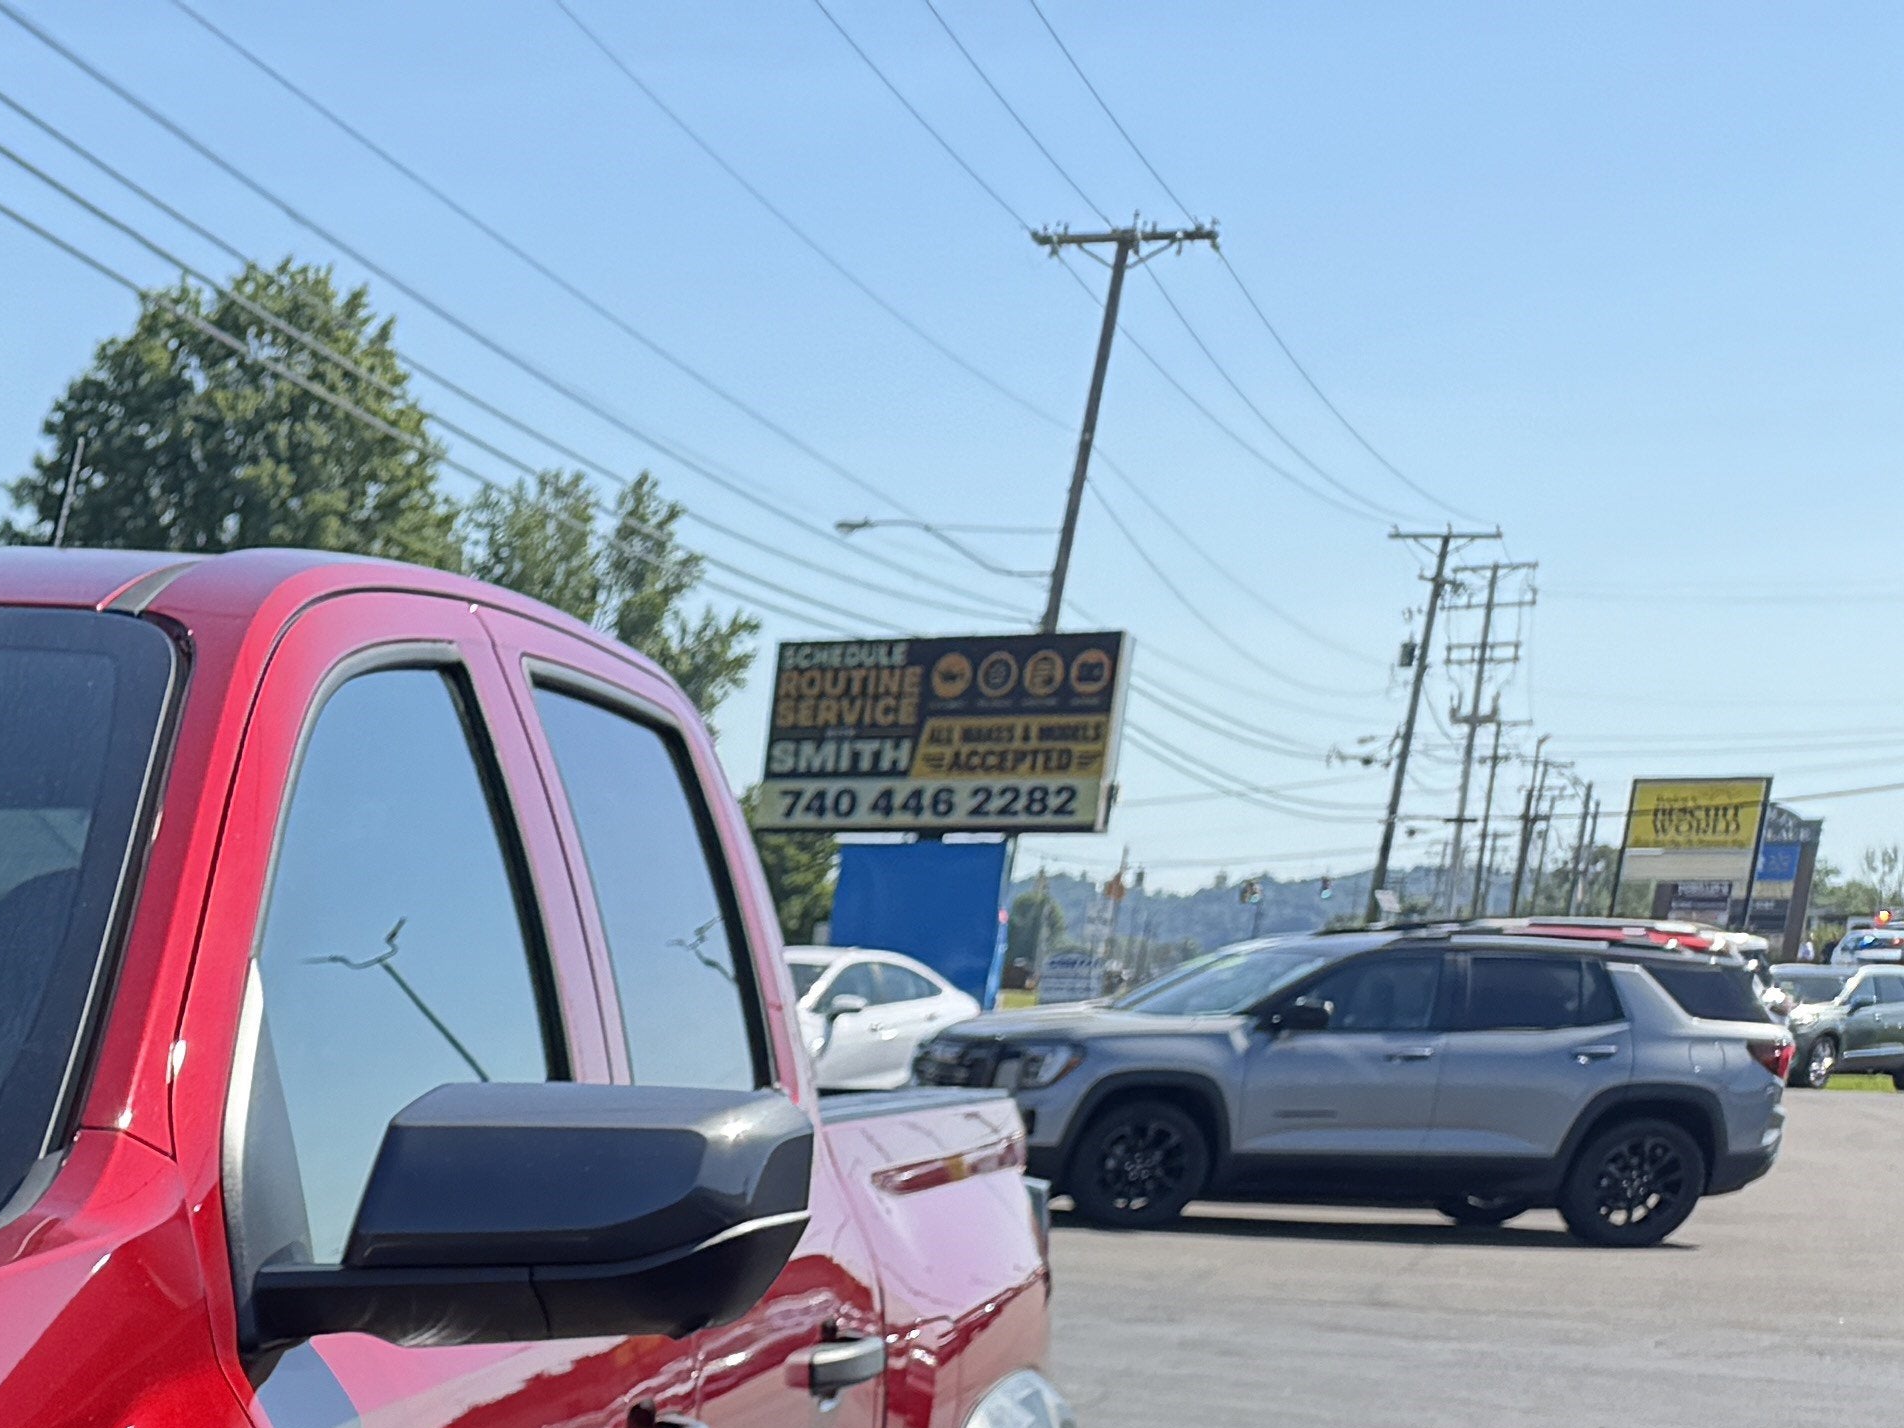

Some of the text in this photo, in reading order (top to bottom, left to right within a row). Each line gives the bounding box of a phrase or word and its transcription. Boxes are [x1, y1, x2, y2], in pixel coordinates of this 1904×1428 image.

[782, 641, 909, 670] SCHEDULE
[779, 665, 924, 698] ROUTINE
[774, 694, 920, 728] SERVICE
[769, 736, 913, 774] SMITH
[947, 750, 1074, 773] ACCEPTED
[779, 784, 1078, 819] 740 446 2282
